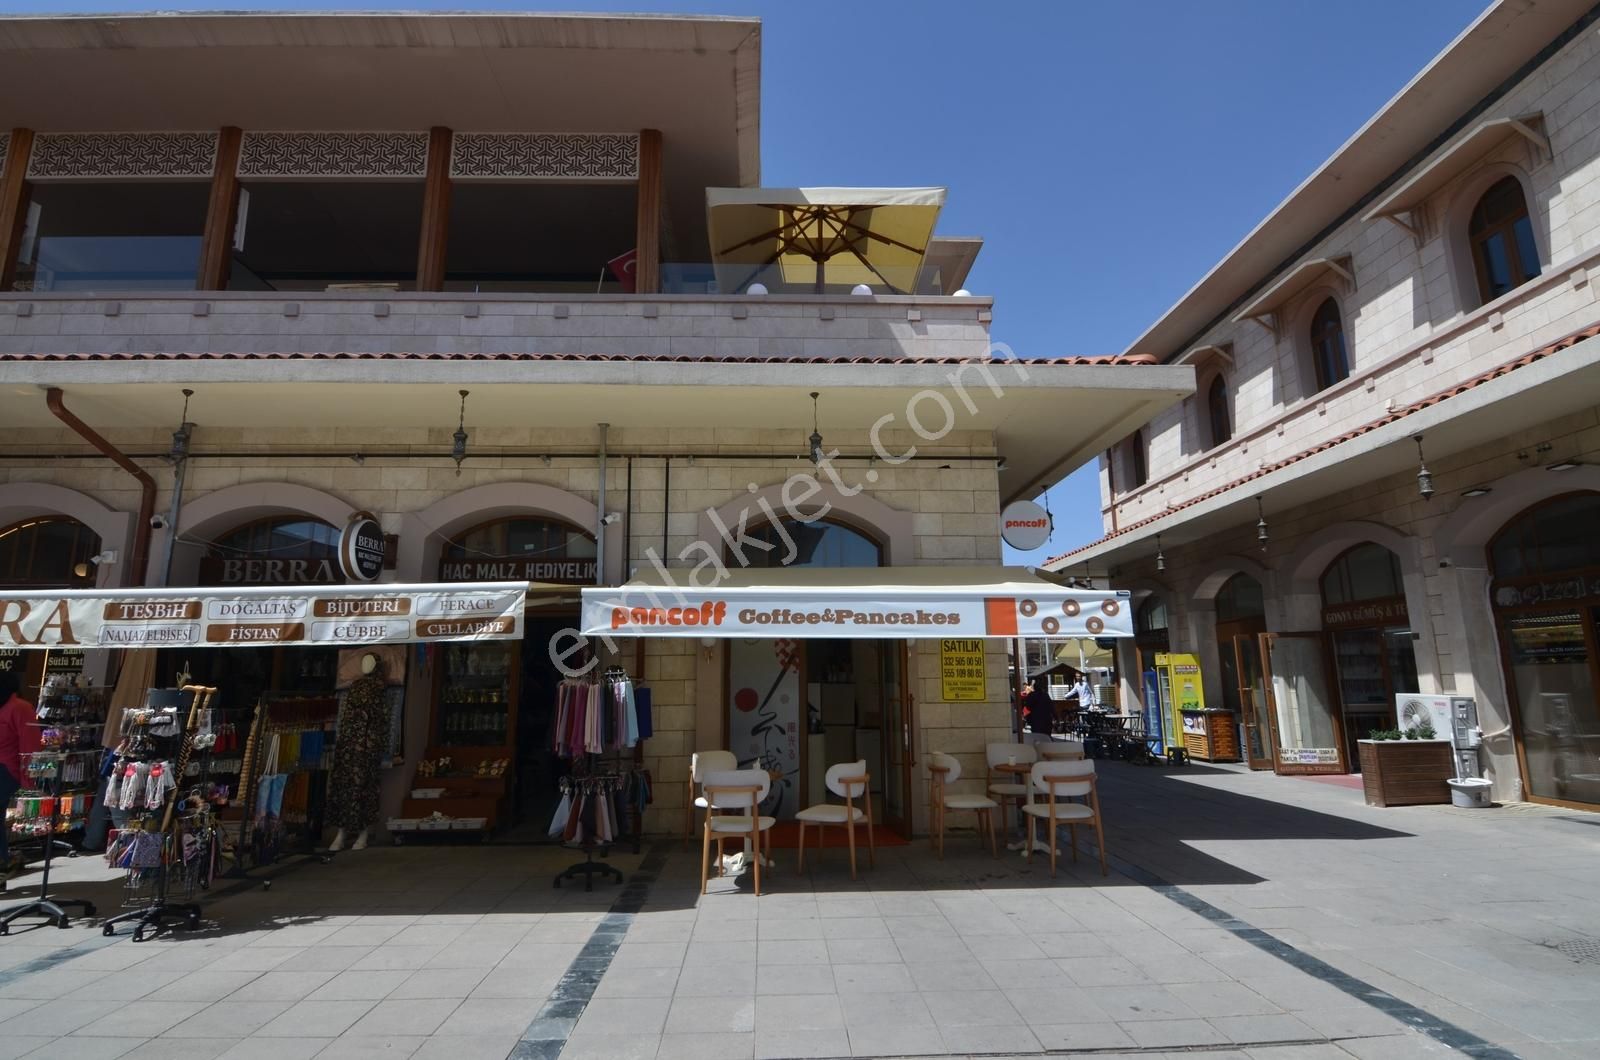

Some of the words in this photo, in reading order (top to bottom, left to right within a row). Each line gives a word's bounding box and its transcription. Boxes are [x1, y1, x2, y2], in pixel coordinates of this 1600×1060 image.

[1005, 519, 1047, 529] pancoff
[358, 536, 384, 552] BERRA
[221, 559, 337, 583] BERRA
[443, 563, 472, 579] HAC
[476, 563, 520, 579] MALZ.
[219, 602, 297, 617] DOĞALTAŞ
[440, 598, 496, 611] FERACE
[611, 600, 728, 630] pancoff
[738, 607, 961, 625] Coffee&Pancakes
[229, 626, 281, 640] FİSTAN
[333, 624, 387, 637] CÜBBE
[943, 640, 981, 653] SATILIK
